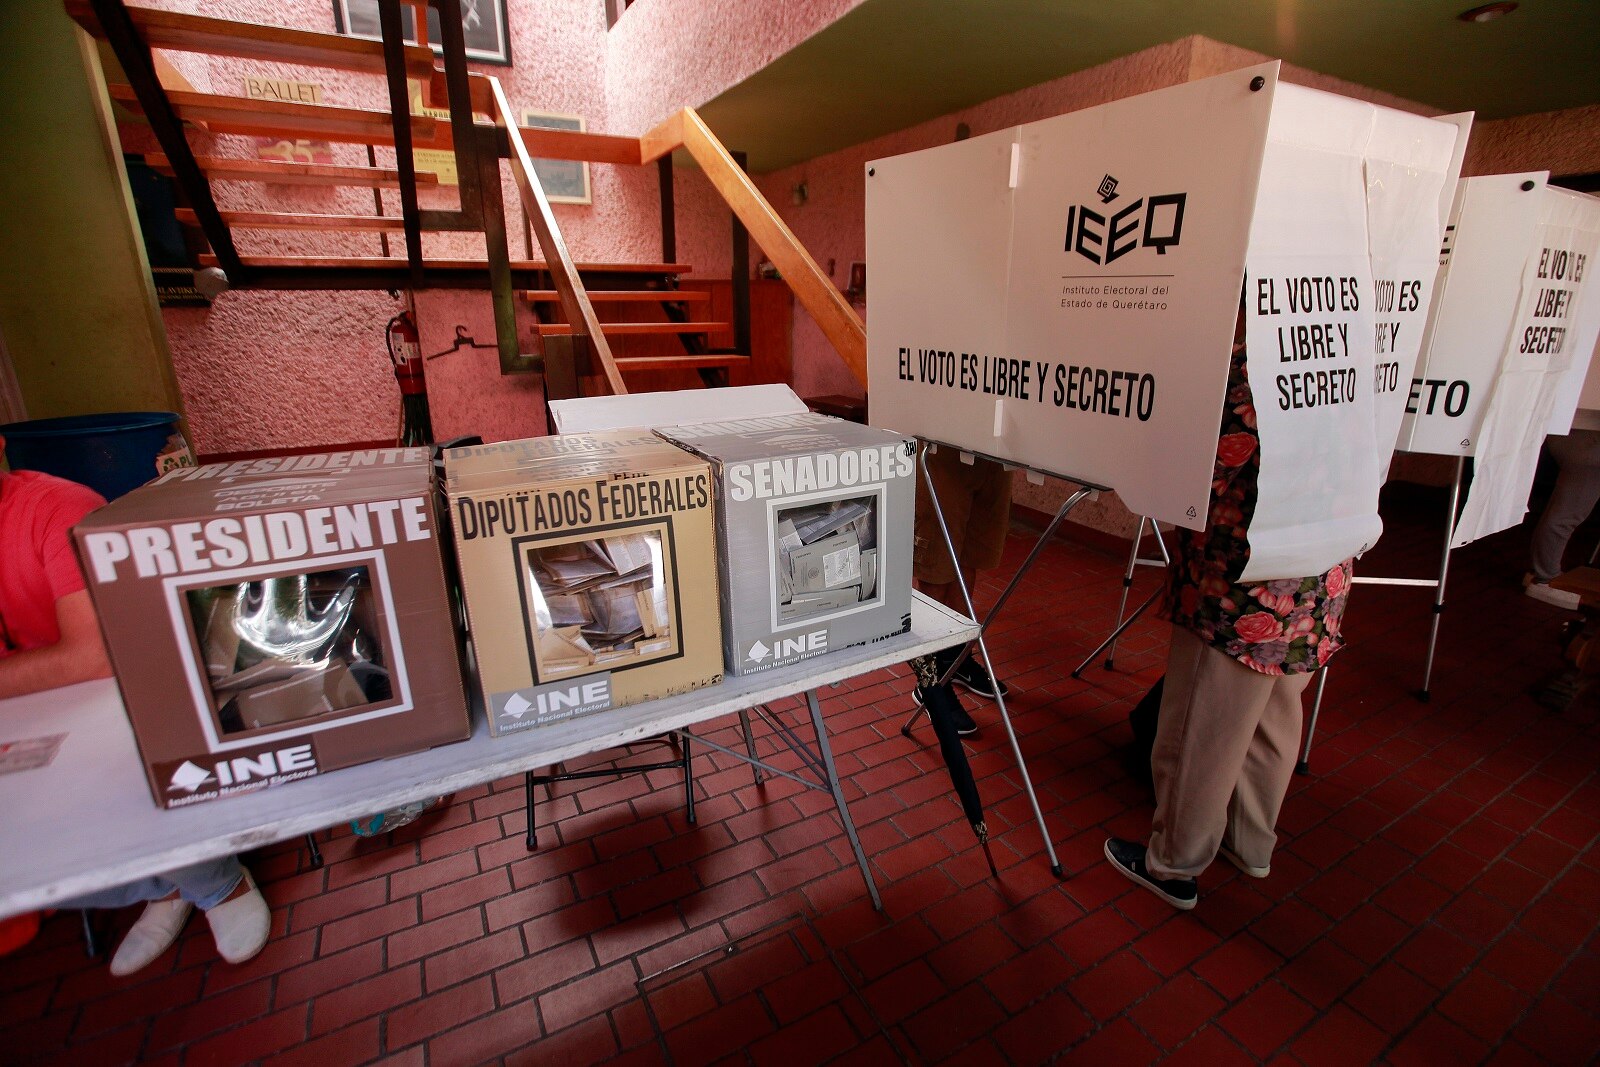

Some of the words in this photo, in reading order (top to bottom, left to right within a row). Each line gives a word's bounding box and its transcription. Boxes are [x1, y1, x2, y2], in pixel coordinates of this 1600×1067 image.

[247, 79, 317, 103] BALLET
[1064, 192, 1187, 266] IEEQ
[1061, 299, 1092, 308] Estado
[1096, 299, 1108, 309] de
[1112, 299, 1168, 310] Querétaro
[1062, 285, 1100, 295] Instituto
[1103, 285, 1148, 295] Electoral
[1151, 286, 1169, 295] del
[1257, 278, 1281, 316] EL
[1286, 276, 1335, 314] VOTO
[1339, 276, 1359, 312] ES
[1398, 280, 1421, 312] ES
[1278, 323, 1336, 363] LIBRE
[1338, 322, 1349, 357] Y
[1390, 322, 1401, 353] Y
[898, 347, 914, 381] EL
[918, 348, 956, 388] VOTO
[960, 353, 978, 392] ES
[983, 355, 1031, 400] LIBRE
[1036, 361, 1050, 403] Y
[1053, 363, 1155, 422] SECRETO
[1276, 368, 1356, 411] SECRETO
[152, 448, 425, 487] PRESIDENTE
[729, 443, 914, 502] SENADORES
[215, 494, 321, 511] BOLETA
[457, 488, 593, 541] DIPUTADOS
[596, 474, 709, 522] FEDERALES
[84, 497, 431, 583] PRESIDENTE
[744, 663, 772, 675] Instituto
[773, 656, 800, 668] Nacional
[801, 648, 828, 660] Electoral
[774, 629, 828, 660] INE
[500, 719, 535, 732] Instituto
[538, 708, 573, 725] Nacional
[575, 700, 610, 715] Electoral
[537, 680, 609, 715] INE
[215, 743, 316, 786] INE
[168, 790, 219, 808] Instituto
[221, 778, 268, 796] Nacional
[270, 766, 318, 785] Electoral
